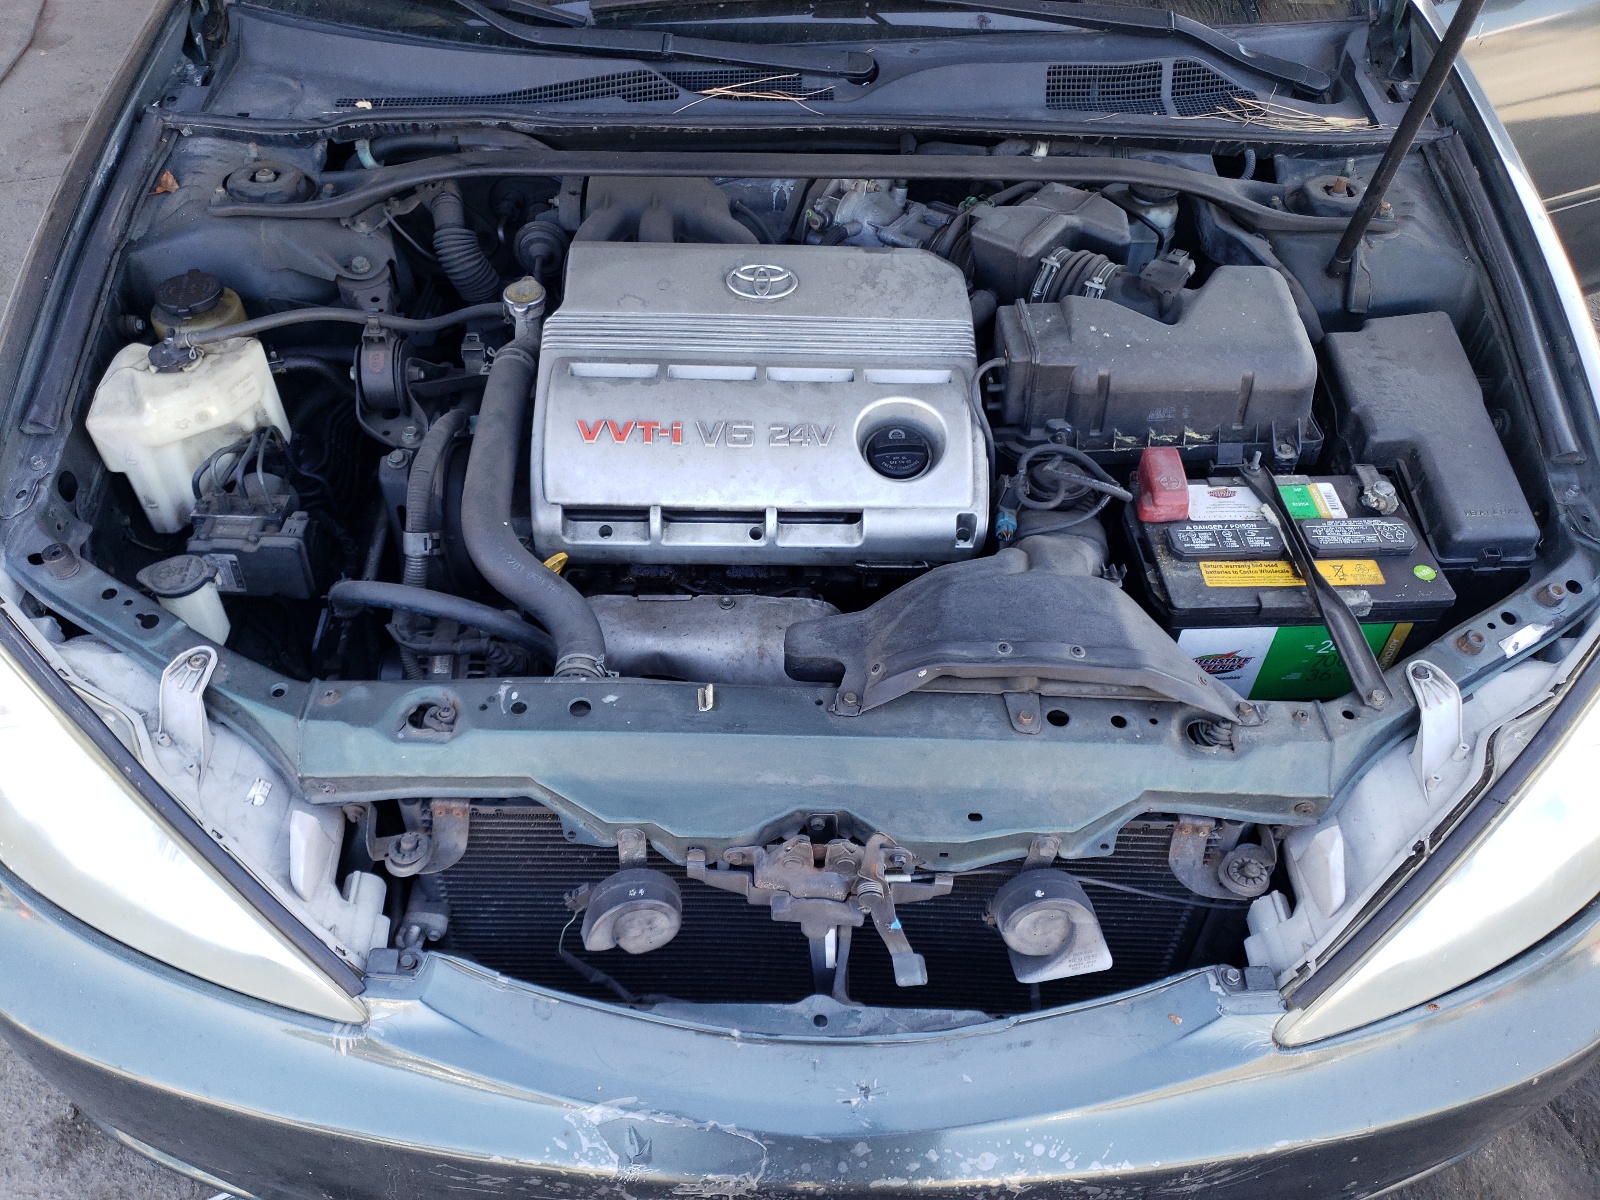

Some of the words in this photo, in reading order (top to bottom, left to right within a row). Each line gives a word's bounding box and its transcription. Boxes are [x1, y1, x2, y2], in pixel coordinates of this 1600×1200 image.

[576, 420, 682, 446] VVT-i
[695, 421, 755, 448] V6
[769, 423, 836, 447] 24V
